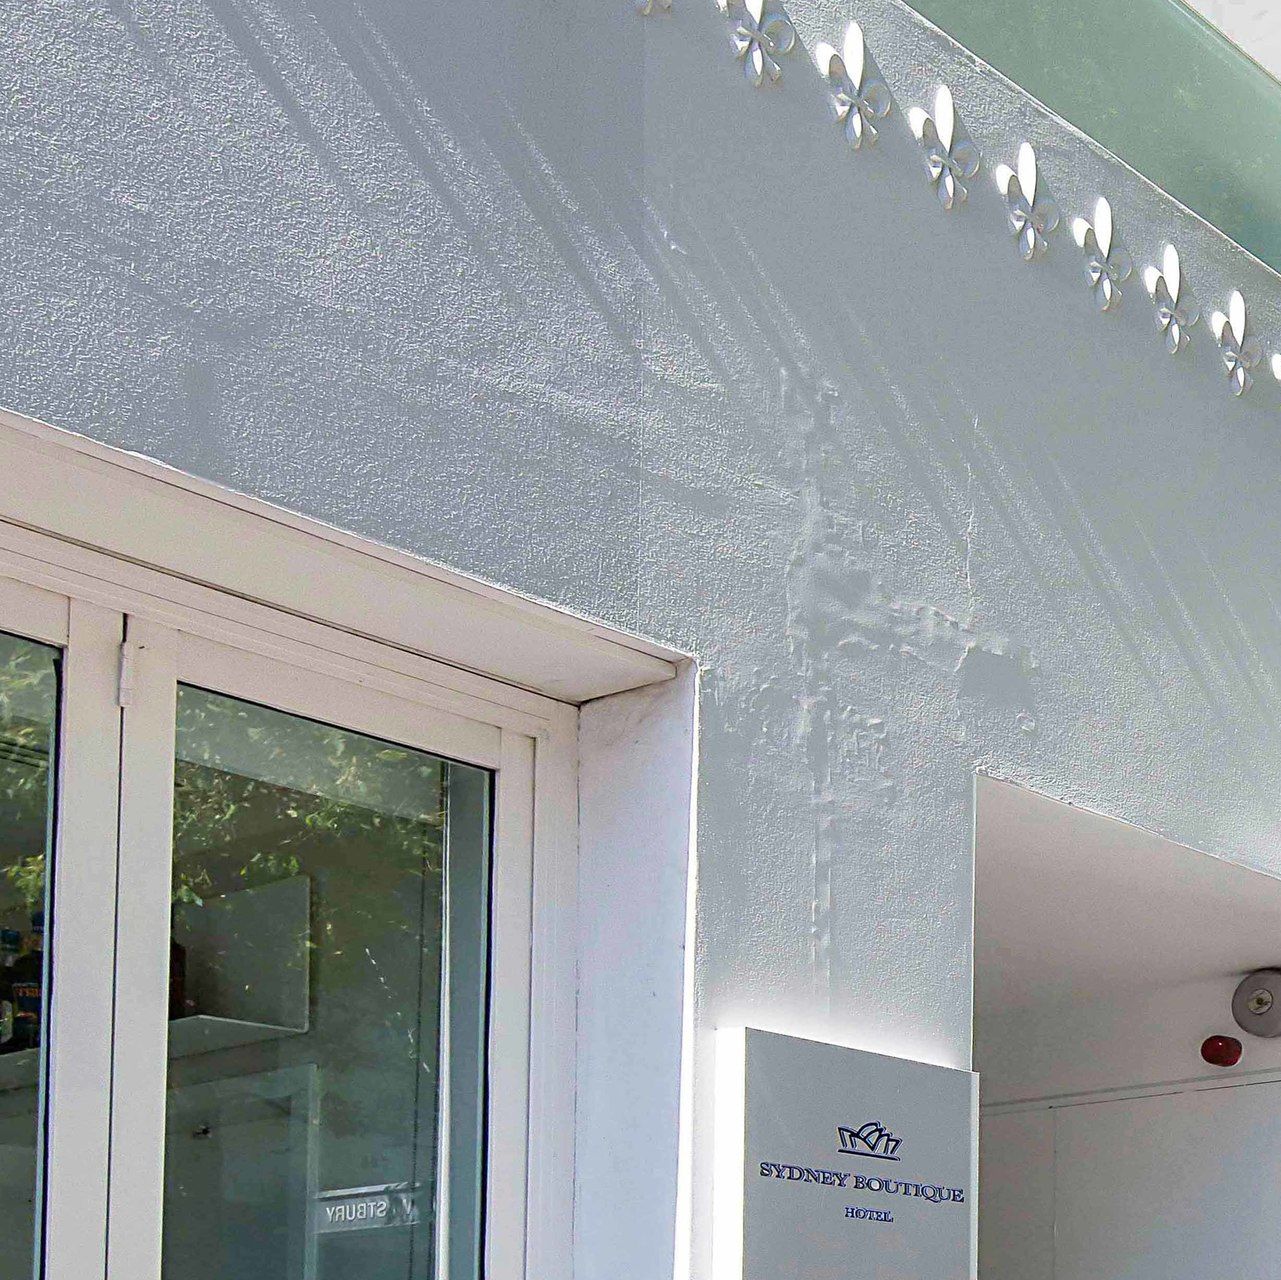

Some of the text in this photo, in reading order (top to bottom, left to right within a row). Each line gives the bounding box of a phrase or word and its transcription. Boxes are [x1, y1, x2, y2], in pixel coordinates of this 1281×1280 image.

[759, 1162, 965, 1204] SYDNEY BOUTIQUE
[845, 1207, 893, 1223] HOTEL
